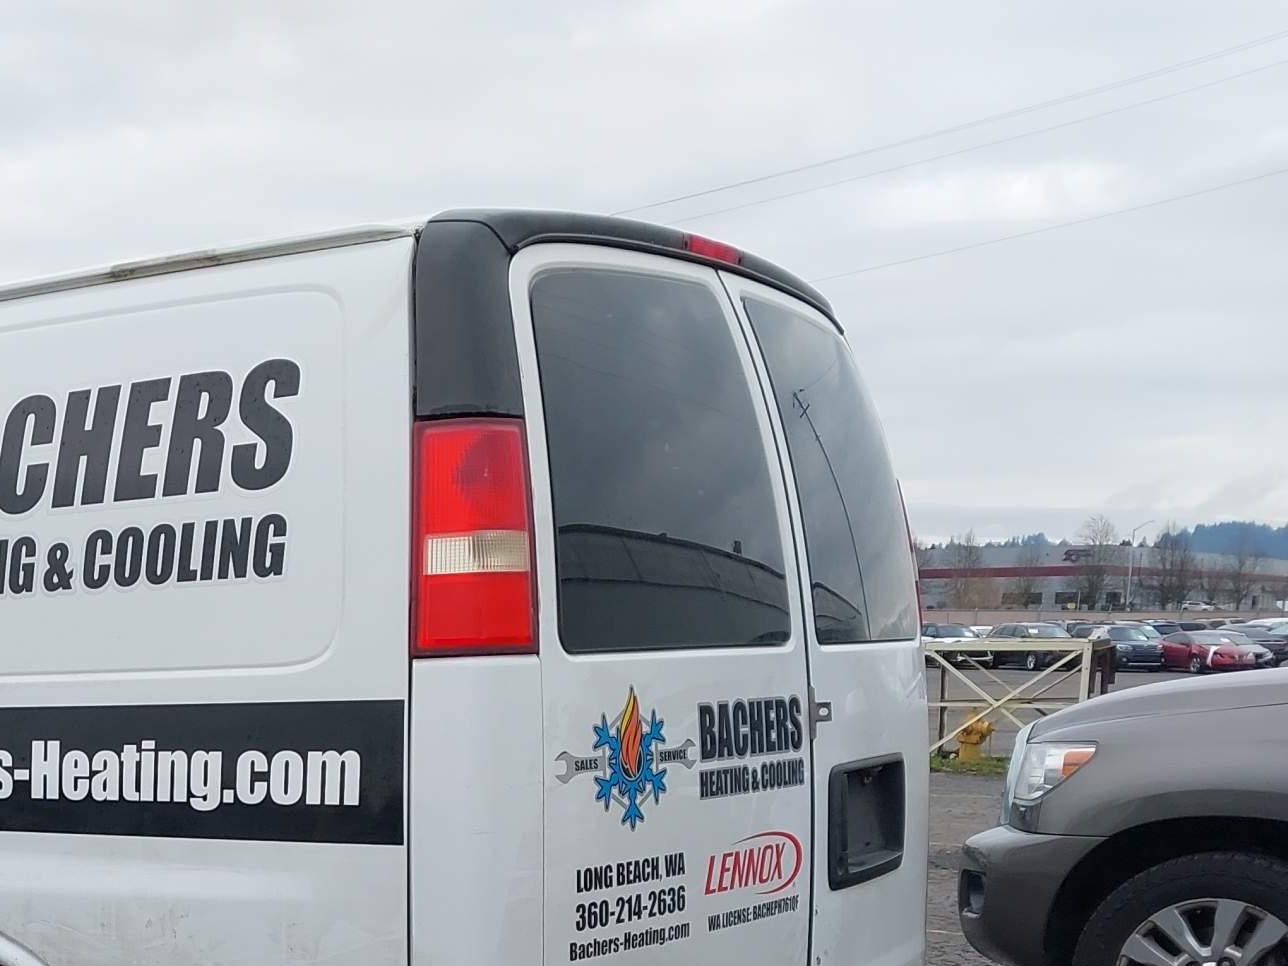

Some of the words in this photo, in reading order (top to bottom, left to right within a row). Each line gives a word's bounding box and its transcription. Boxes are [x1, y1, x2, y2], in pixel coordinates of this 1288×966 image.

[43, 542, 73, 592] &
[82, 513, 288, 589] COOLING
[699, 696, 803, 761] BACHERS
[574, 759, 599, 772] SALES
[659, 749, 688, 762] SERVICE
[699, 766, 750, 798] HEATING
[751, 767, 760, 791] &
[761, 758, 804, 789] COOLING
[576, 864, 613, 893] LONG
[616, 856, 663, 887] BEACH,
[664, 852, 685, 878] WA
[704, 842, 786, 895] LENNOX
[575, 885, 686, 932] 360-214-2636
[707, 914, 721, 932] WA
[722, 907, 752, 929] LICENSE:
[569, 922, 691, 962] Bachers-Heating.com
